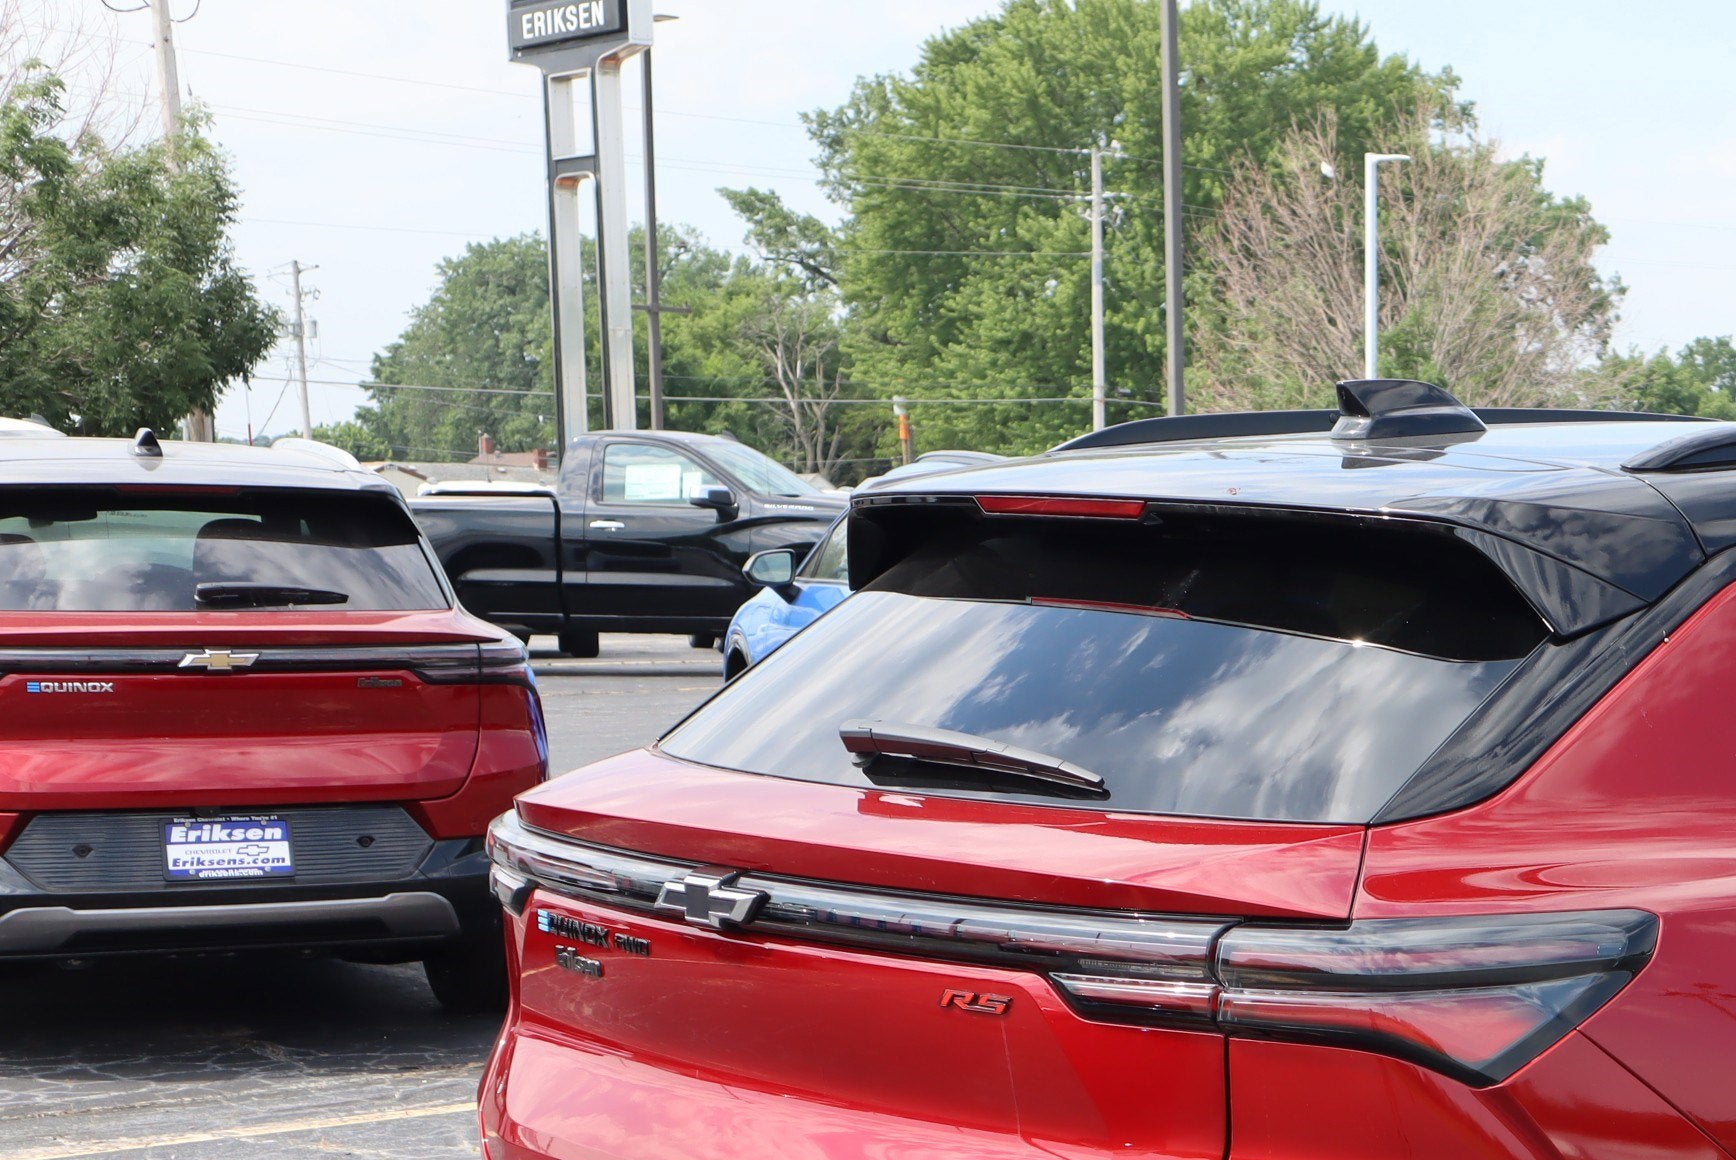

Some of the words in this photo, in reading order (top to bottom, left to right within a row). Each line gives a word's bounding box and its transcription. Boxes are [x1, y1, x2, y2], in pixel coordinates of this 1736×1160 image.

[521, 1, 605, 39] ERIKSEN
[26, 681, 114, 693] EQUINOX
[170, 823, 283, 843] Eriksen
[172, 856, 286, 868] Eriksens.com
[939, 988, 1013, 1015] RS
